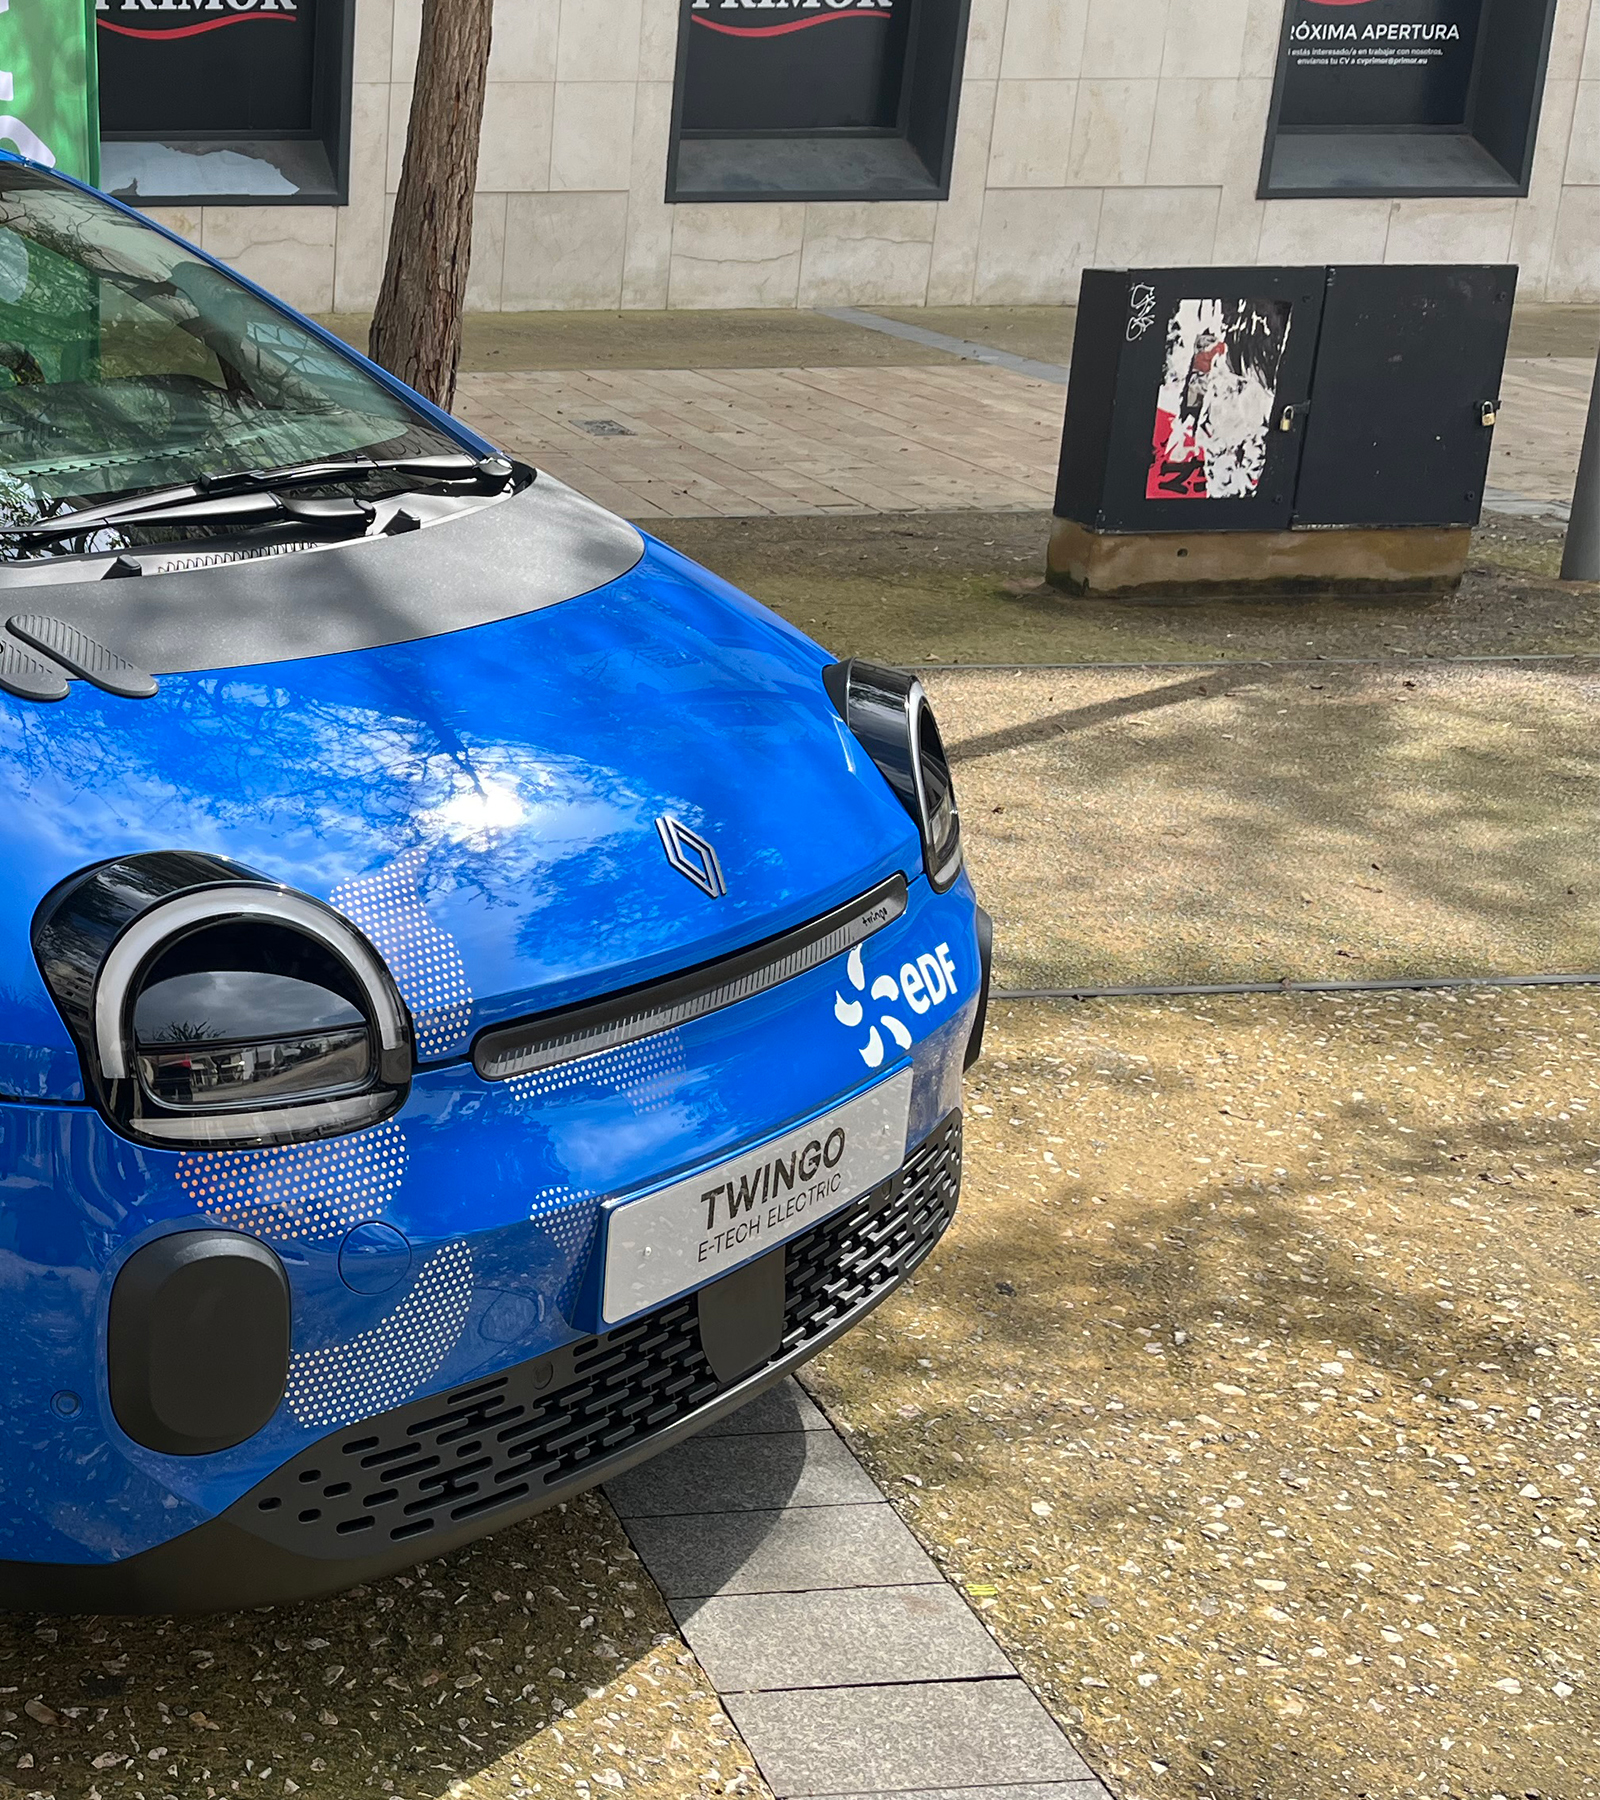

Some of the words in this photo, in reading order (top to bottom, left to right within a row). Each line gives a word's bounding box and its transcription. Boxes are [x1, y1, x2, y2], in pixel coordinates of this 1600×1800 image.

[1290, 20, 1358, 40] ÓXIMA
[1360, 24, 1460, 40] APERTURA
[1329, 57, 1338, 65] tu
[1339, 57, 1350, 65] CV
[1368, 48, 1396, 57] trabajar
[700, 1127, 846, 1230] TWINGO
[698, 1215, 761, 1263] E-TECH
[767, 1173, 842, 1229] ELECTRIC
